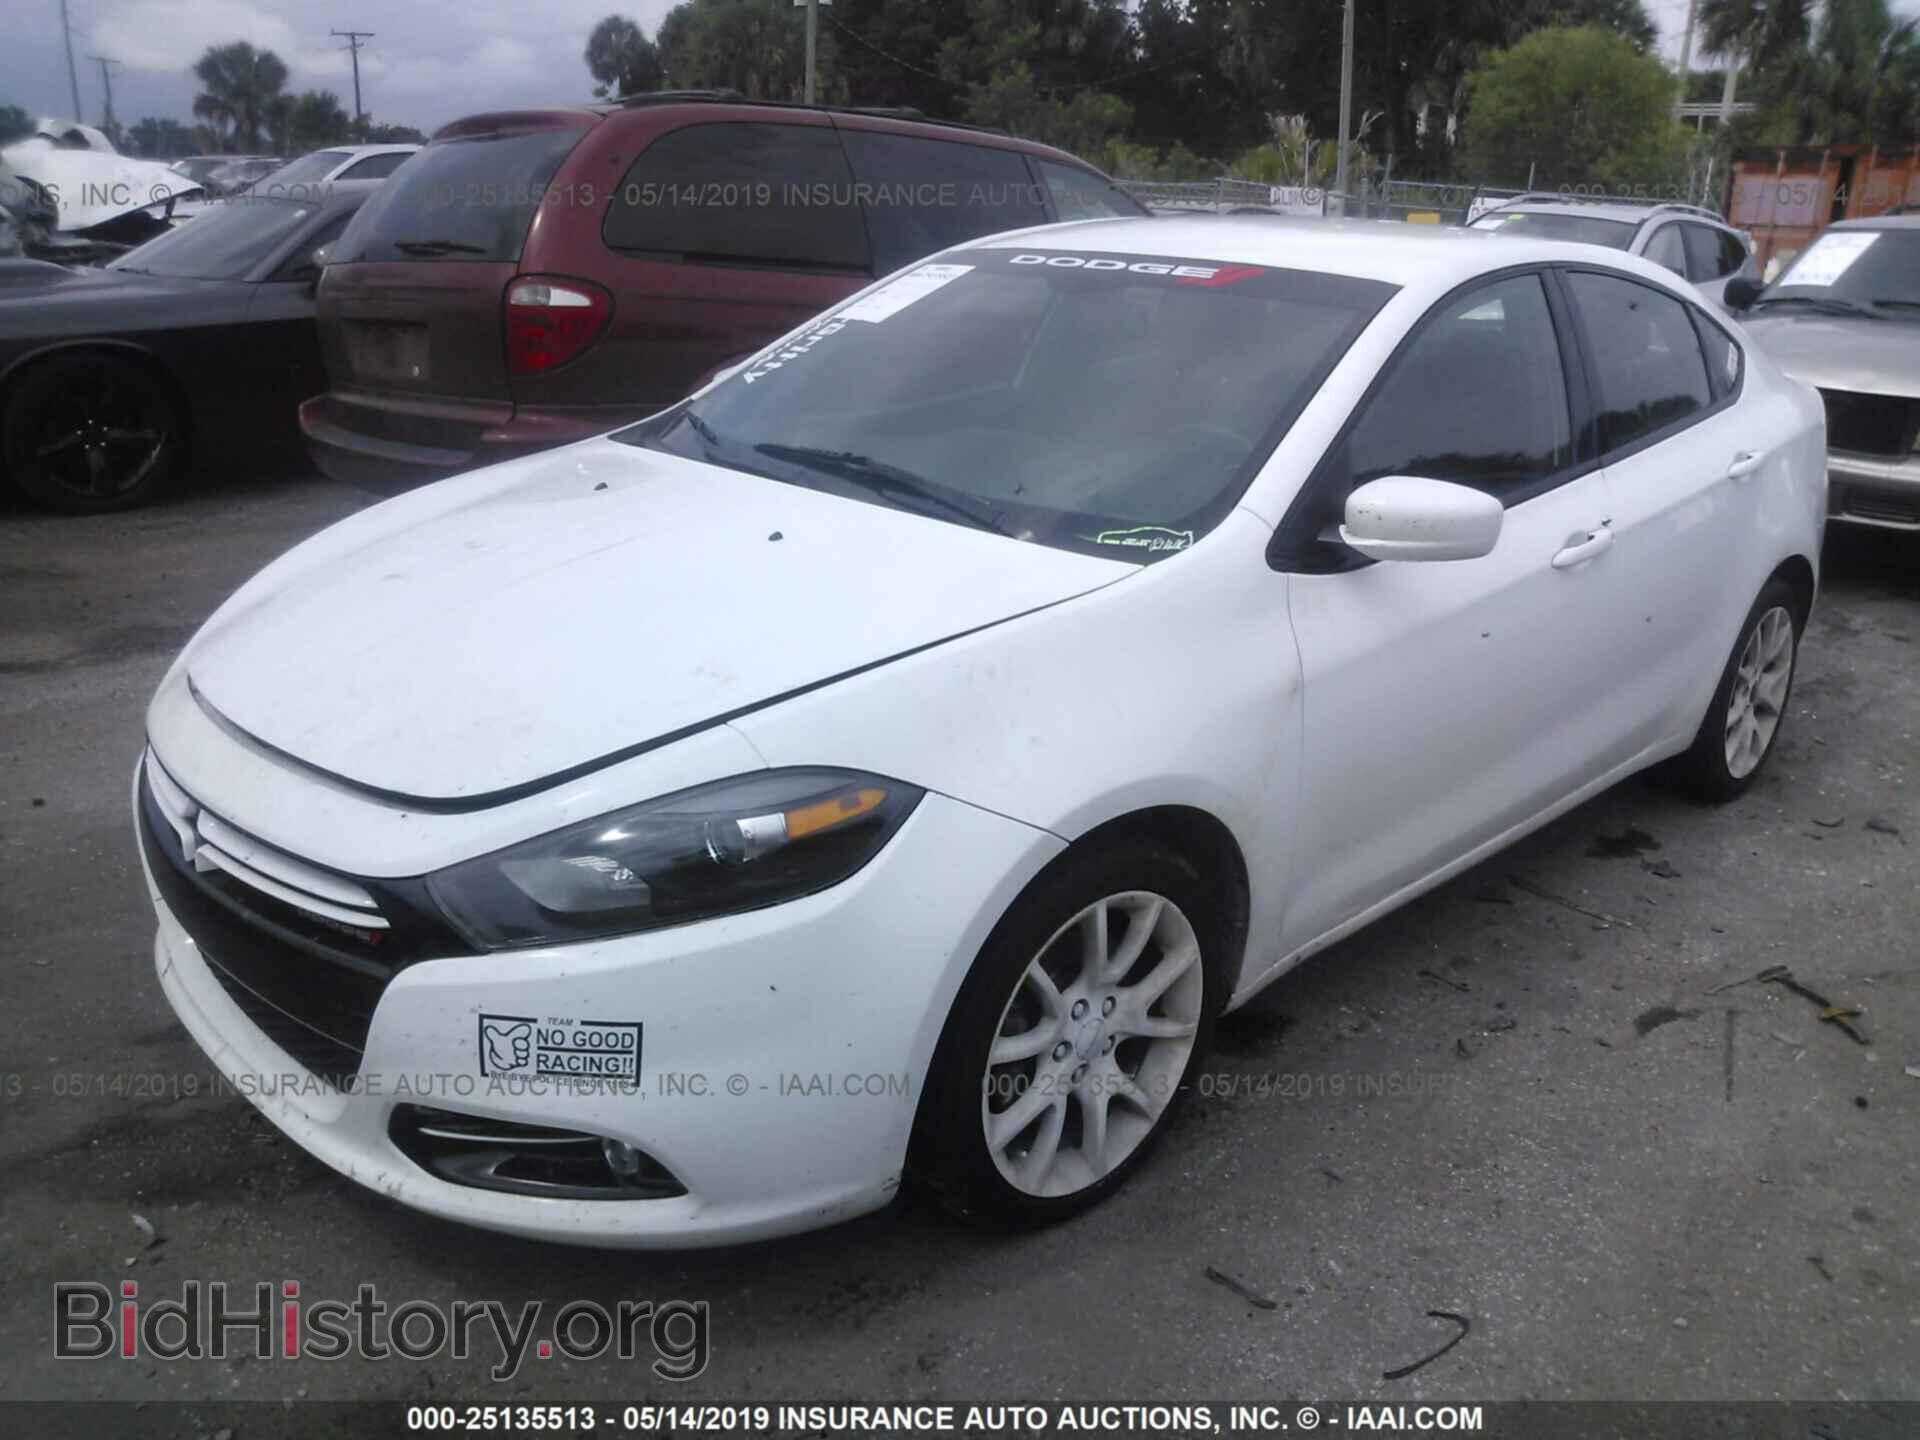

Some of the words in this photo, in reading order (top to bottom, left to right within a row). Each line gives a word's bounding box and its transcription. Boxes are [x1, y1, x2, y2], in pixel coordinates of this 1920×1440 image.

[1009, 254, 1219, 278] DODGE
[547, 1017, 574, 1026] TEAM
[536, 1028, 566, 1046] NO
[572, 1030, 635, 1049] GOOD
[536, 1053, 635, 1073] RACING!!
